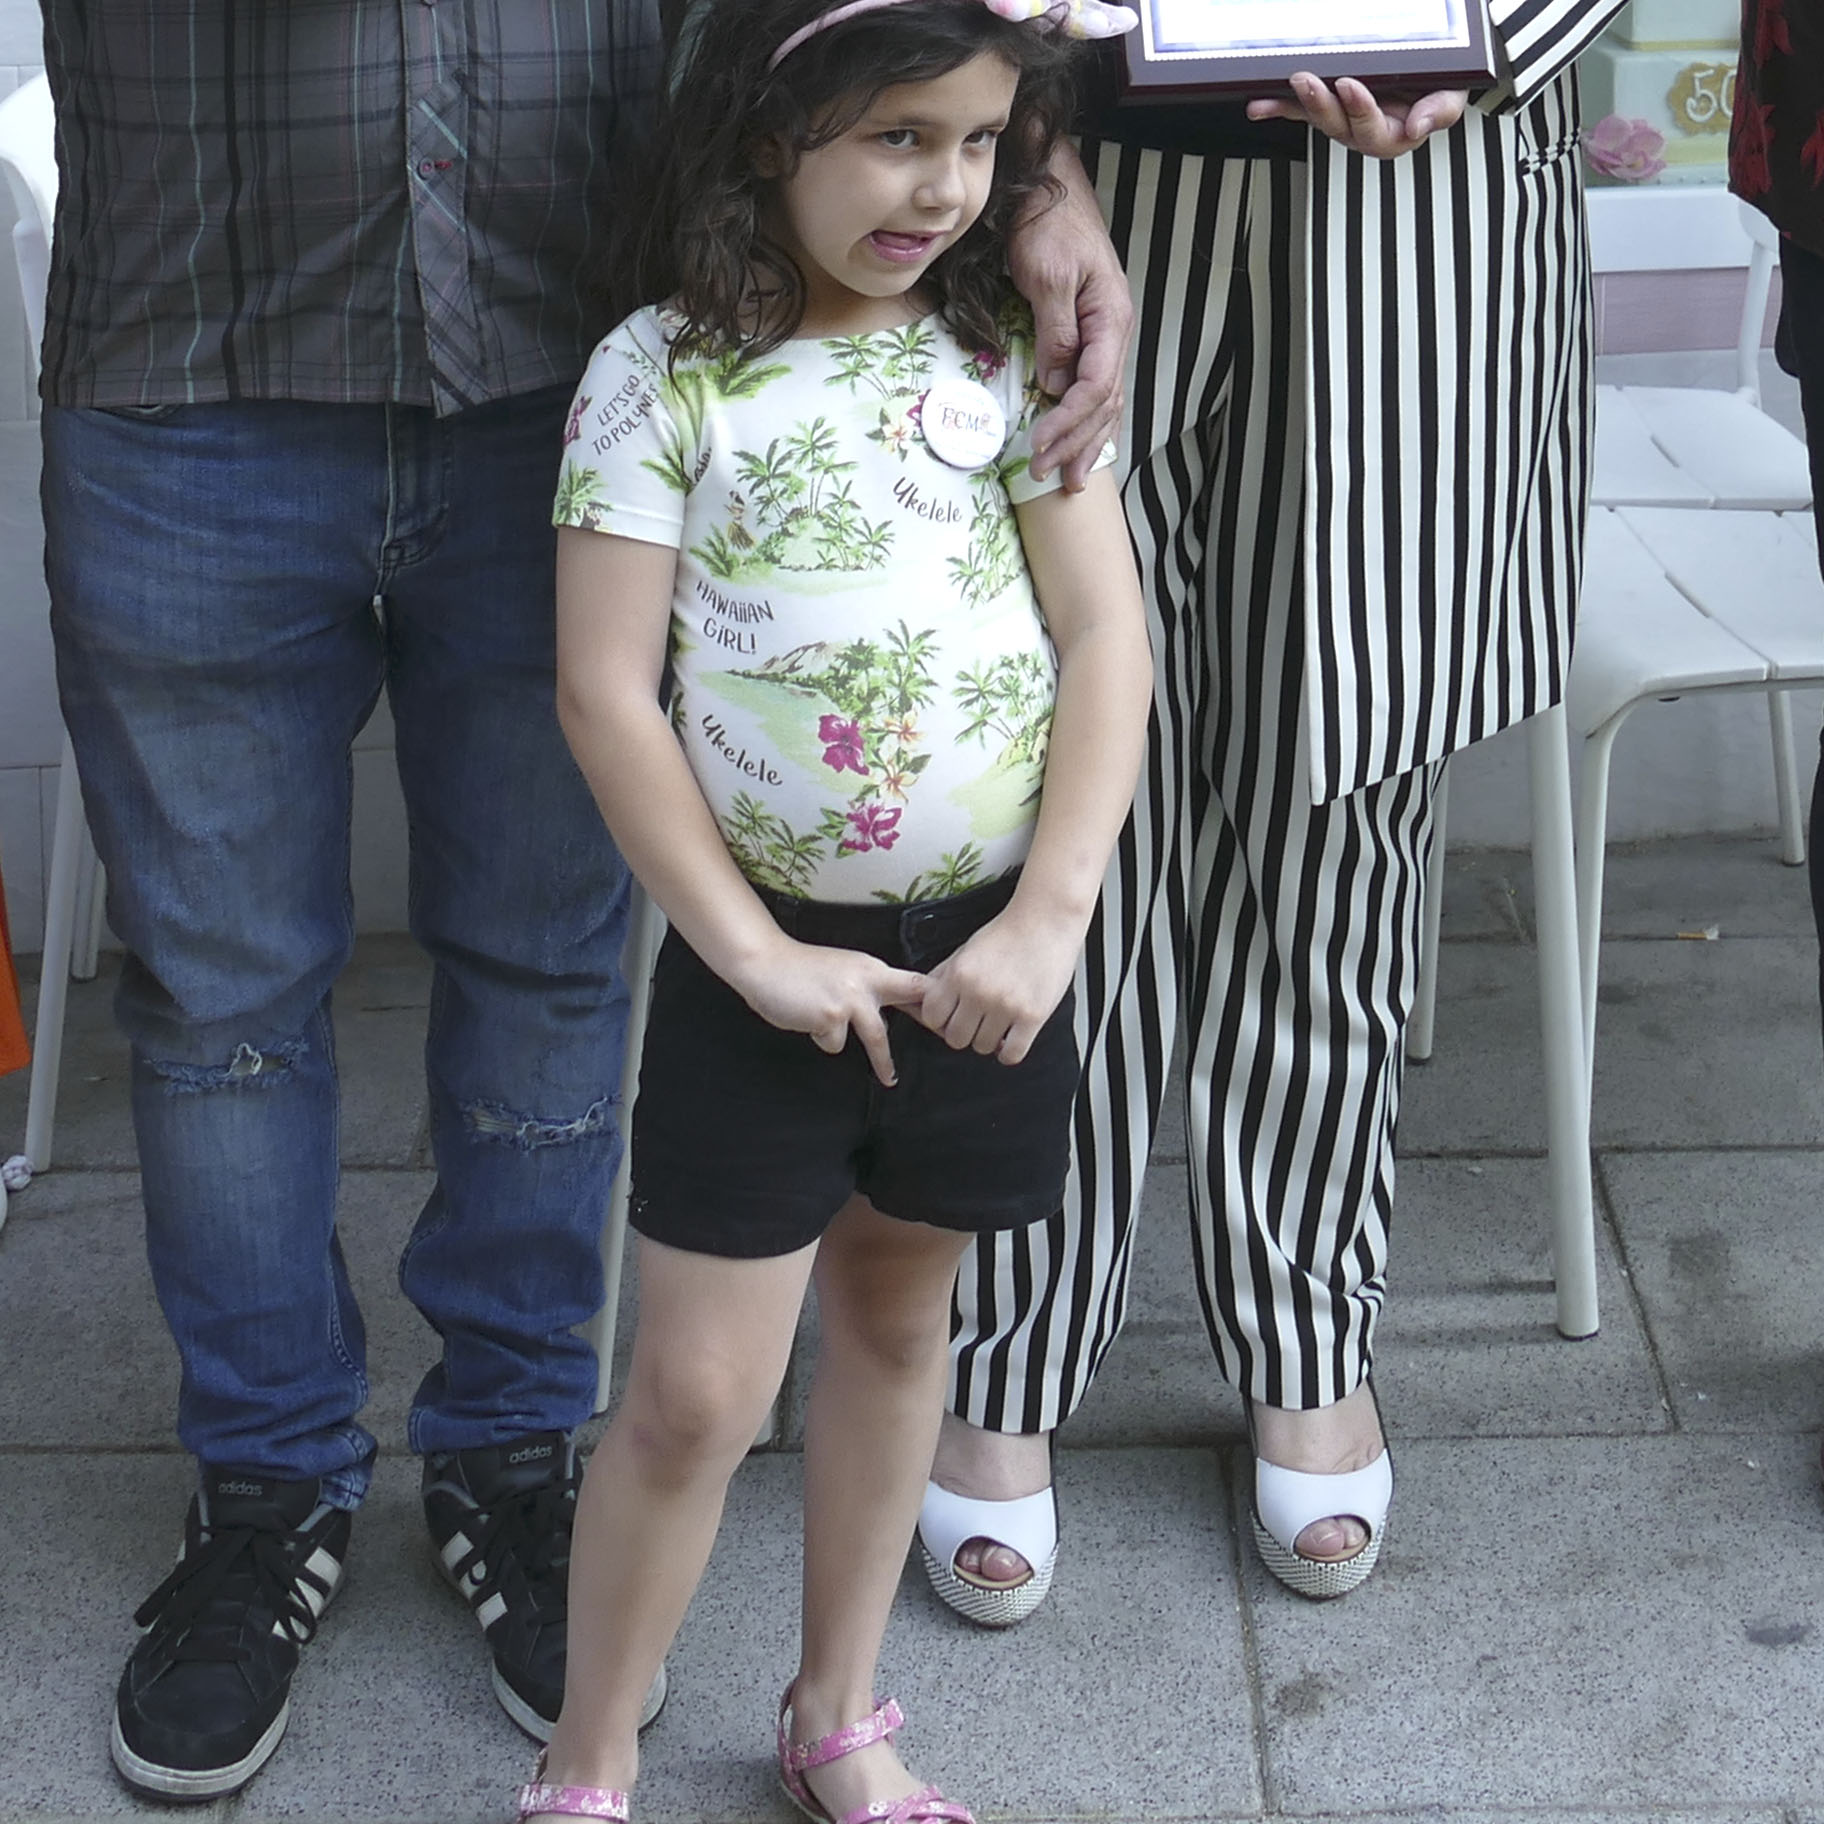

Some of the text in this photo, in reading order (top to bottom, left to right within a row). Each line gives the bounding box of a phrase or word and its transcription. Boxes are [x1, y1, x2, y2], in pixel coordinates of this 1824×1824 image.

[623, 374, 641, 397] GO
[509, 1444, 553, 1463] adidas
[218, 1481, 263, 1497] adidas
